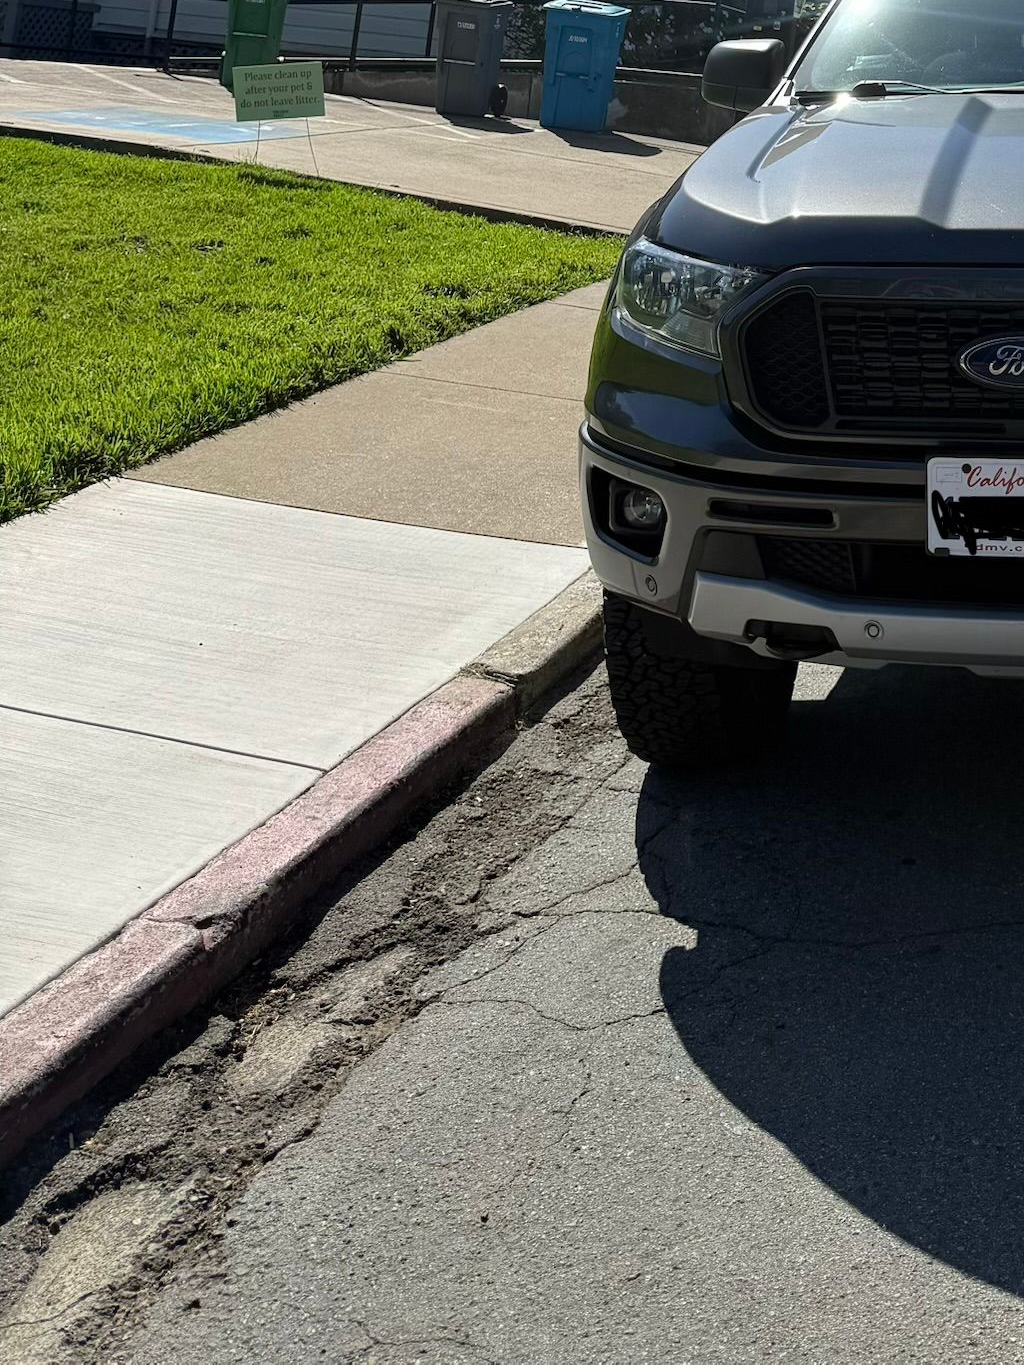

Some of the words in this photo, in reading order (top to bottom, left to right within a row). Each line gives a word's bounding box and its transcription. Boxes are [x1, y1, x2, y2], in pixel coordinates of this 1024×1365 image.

[244, 72, 272, 82] Please
[274, 70, 298, 80] clean
[300, 70, 312, 79] up
[245, 85, 266, 95] after
[268, 86, 289, 96] your
[290, 83, 304, 94] pet
[306, 82, 313, 90] &
[240, 99, 252, 108] do
[254, 99, 269, 107] not
[271, 97, 293, 106] leave
[295, 95, 320, 105] litter.
